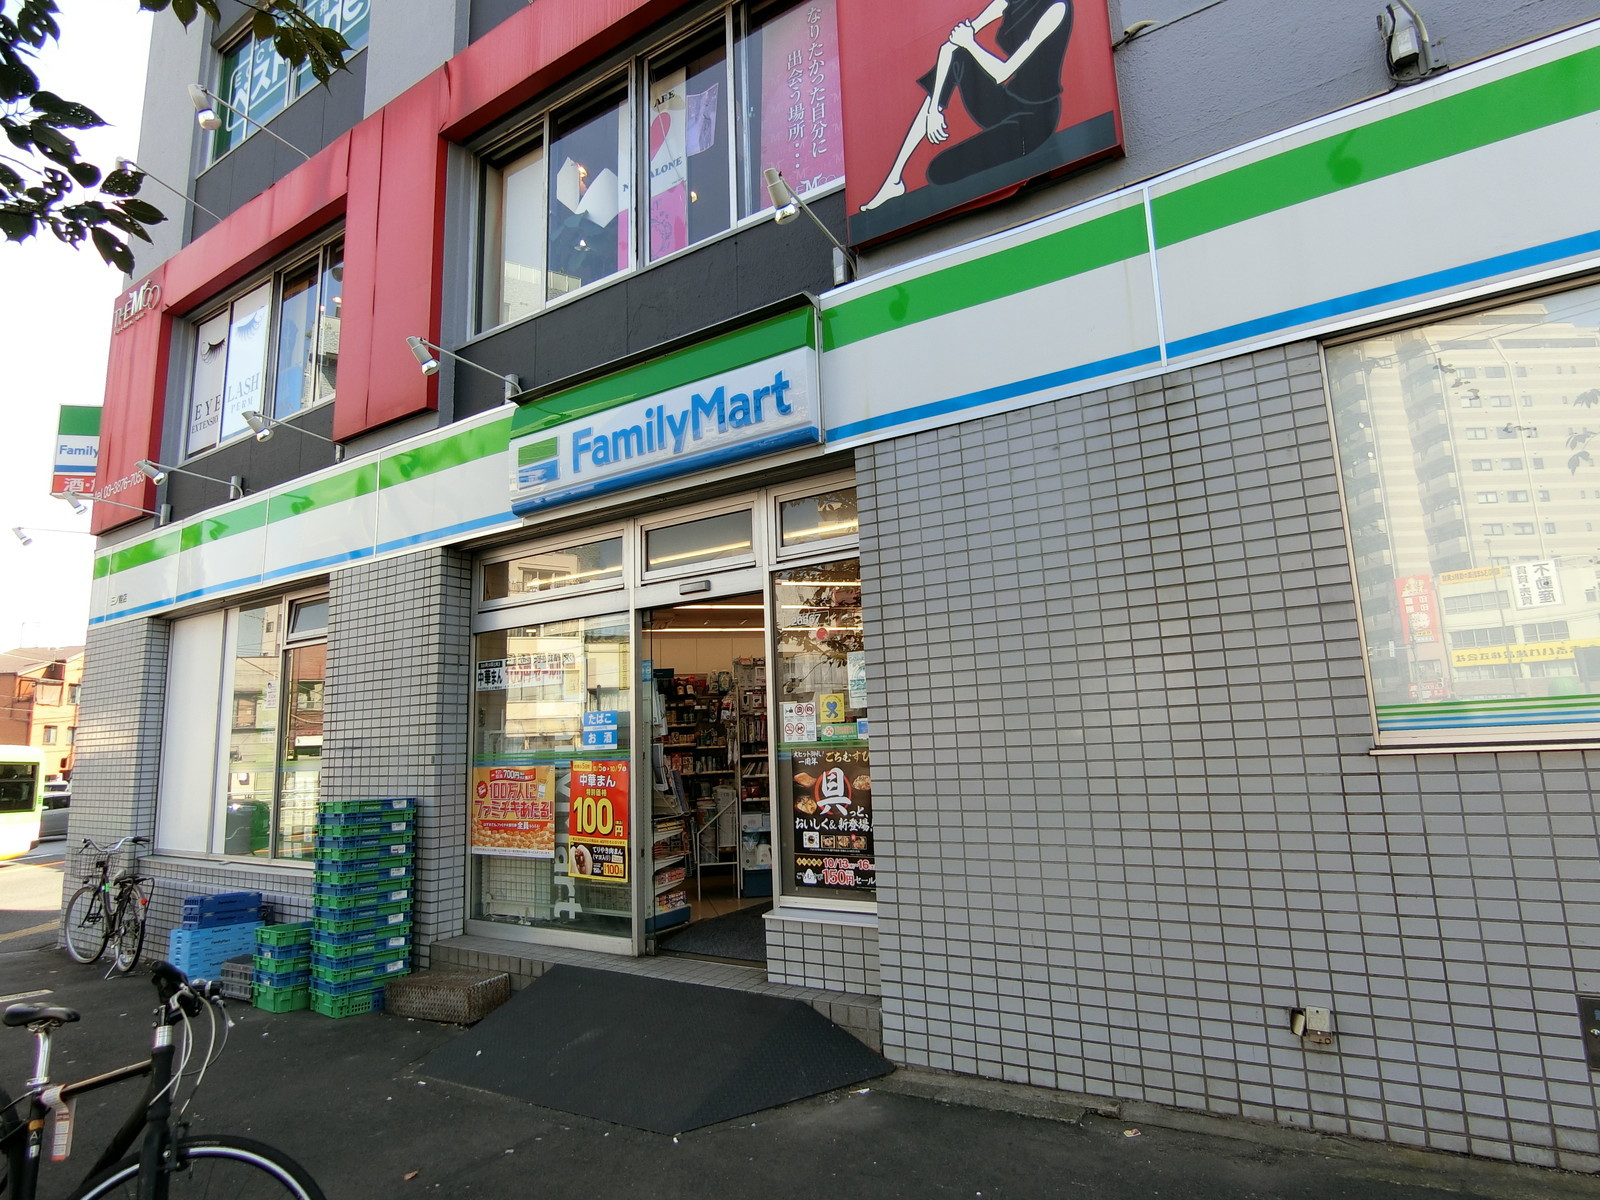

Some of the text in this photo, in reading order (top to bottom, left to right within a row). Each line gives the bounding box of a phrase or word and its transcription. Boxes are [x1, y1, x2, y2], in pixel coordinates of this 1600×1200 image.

[806, 6, 828, 158] なりたかった自分に
[650, 157, 683, 179] ALONE
[194, 372, 260, 421] EYE LASH
[231, 396, 254, 413] PERM
[191, 414, 219, 434] EXTENSIO
[572, 369, 793, 474] FamilyMart
[63, 477, 96, 493] 酒・
[588, 713, 612, 724] たばこ
[588, 731, 613, 744] お酒
[798, 757, 818, 766] 一周年
[579, 773, 616, 787] 中華まん
[489, 782, 537, 800] 100万人に
[474, 800, 553, 820] ファミチキあたる!
[592, 846, 624, 855] てりやき肉まん
